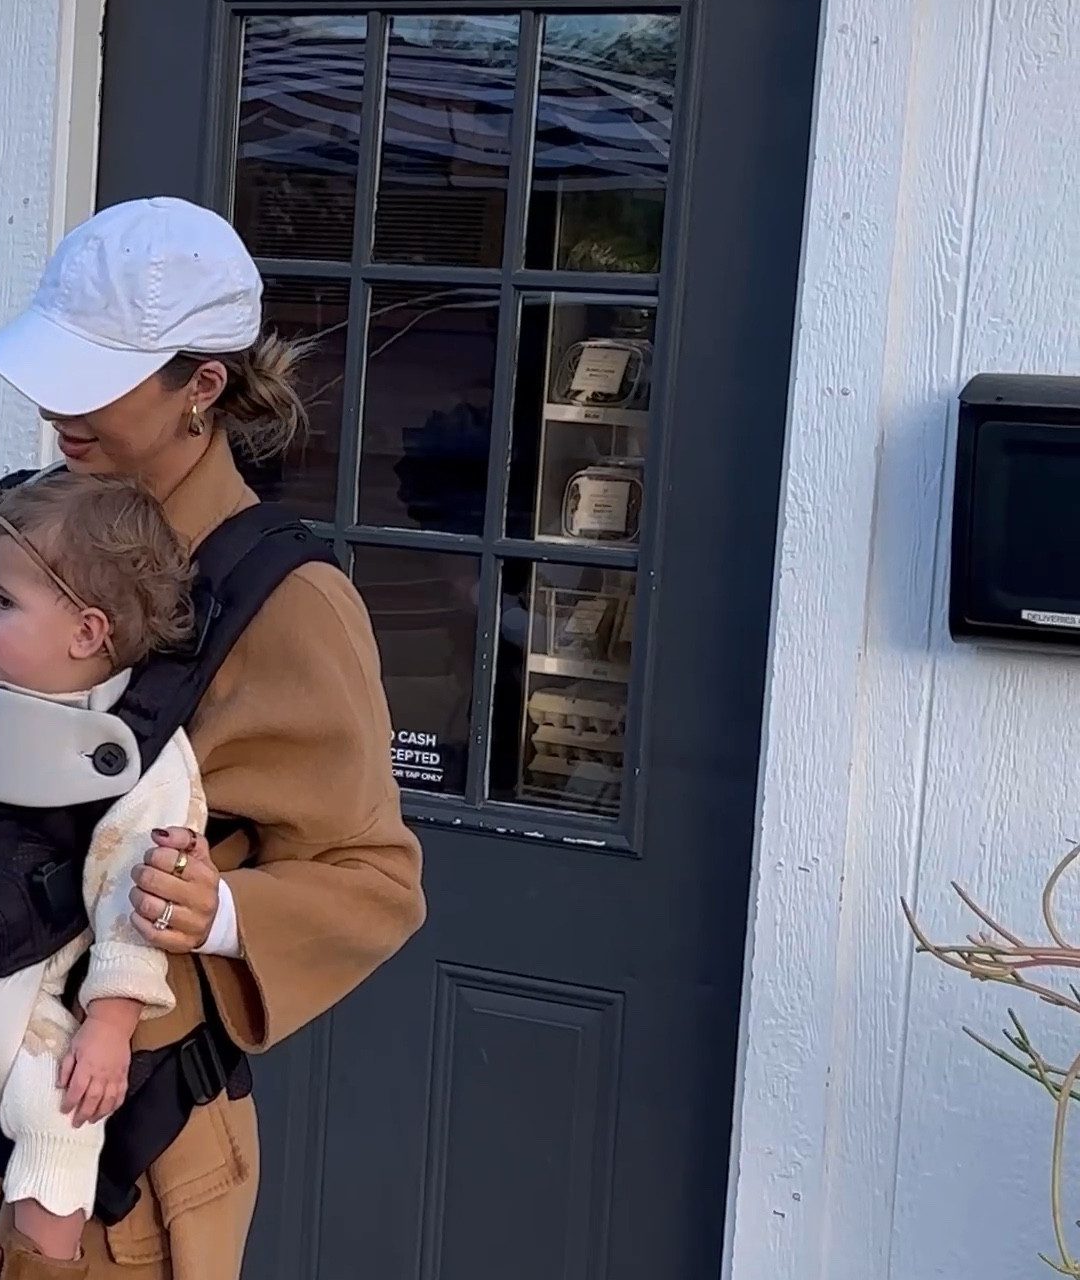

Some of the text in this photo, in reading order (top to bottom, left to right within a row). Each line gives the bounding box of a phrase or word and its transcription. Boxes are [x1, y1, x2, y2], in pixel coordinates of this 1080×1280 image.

[398, 730, 437, 748] CASH
[405, 770, 421, 779] TAP
[421, 772, 443, 783] ONLY
